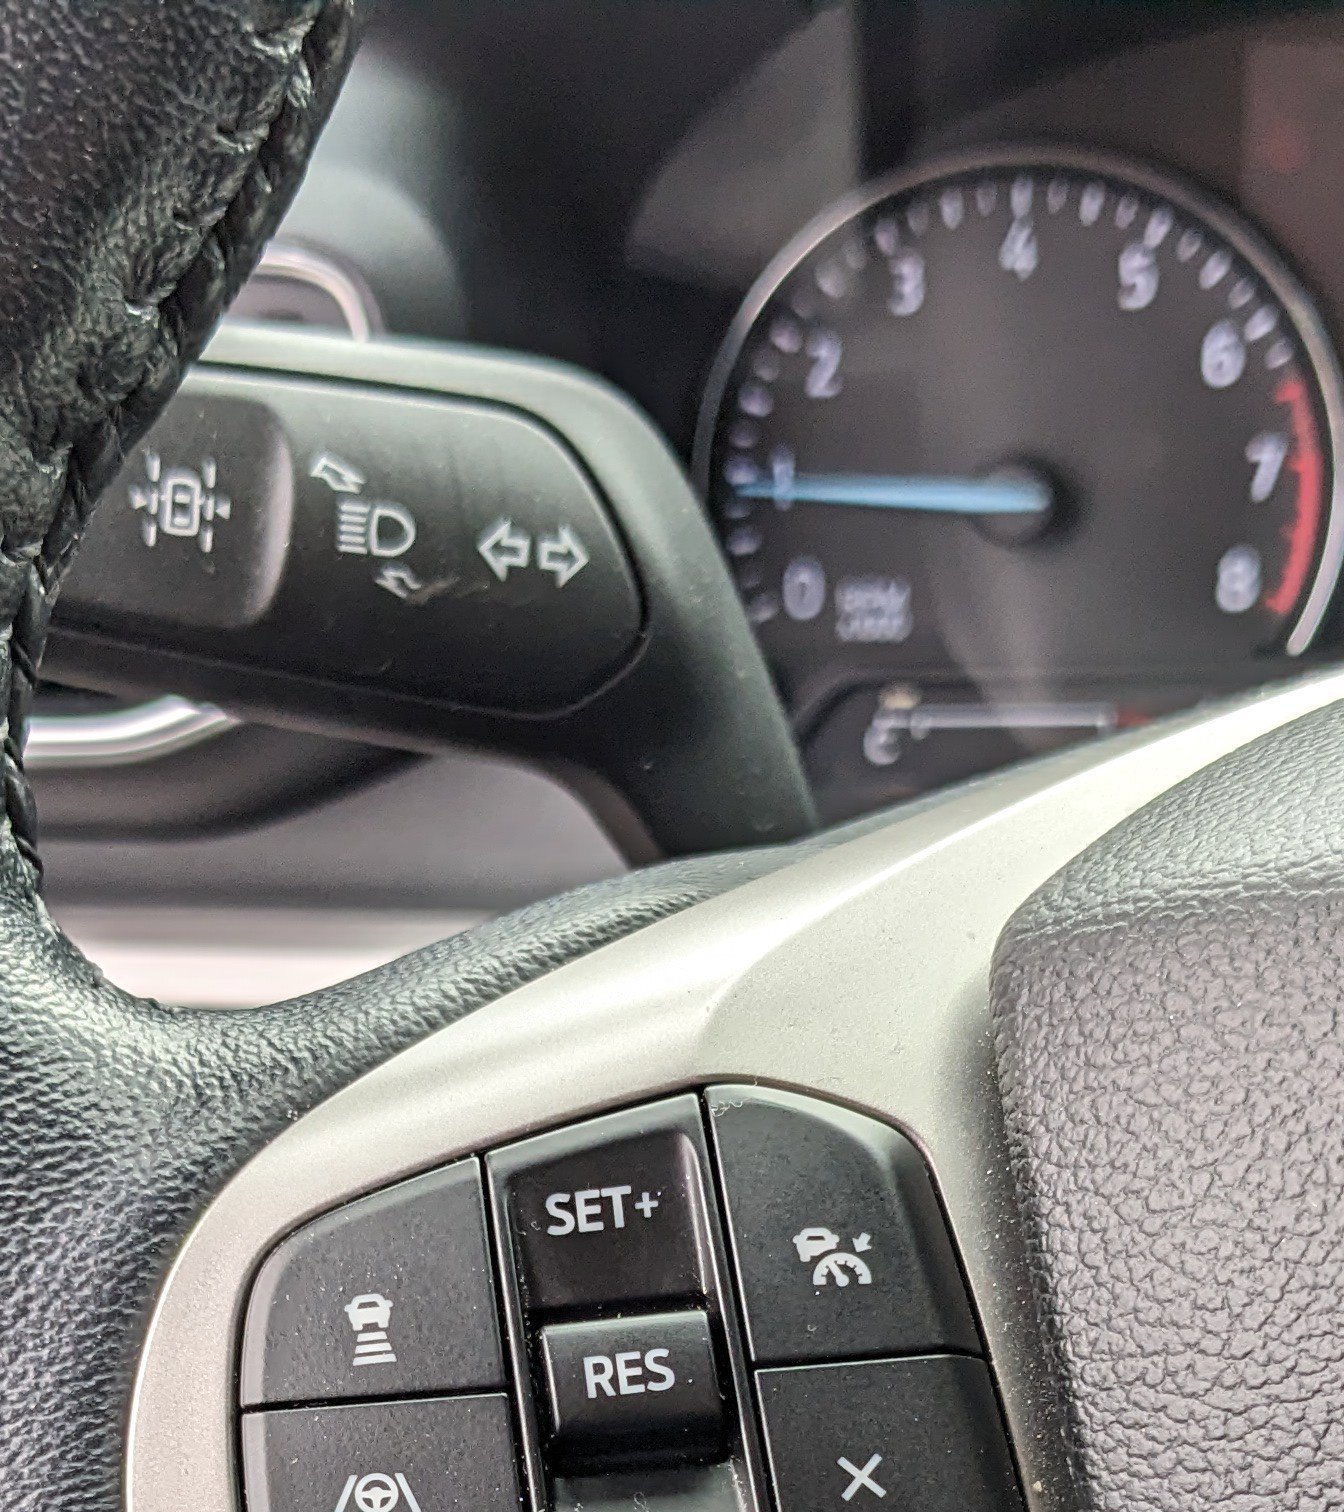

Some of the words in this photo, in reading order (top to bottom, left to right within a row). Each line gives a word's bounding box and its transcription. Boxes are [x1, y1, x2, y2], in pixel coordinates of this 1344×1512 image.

[1000, 216, 1037, 280] 4
[1118, 241, 1157, 310] 5
[889, 252, 925, 316] 3
[805, 329, 842, 399] 2
[1200, 319, 1245, 389] 6
[770, 445, 796, 510] 1
[1246, 431, 1287, 502] 7
[782, 556, 826, 620] 0
[1216, 545, 1260, 613] 8
[545, 1186, 659, 1237] SET+
[584, 1347, 676, 1399] RES
